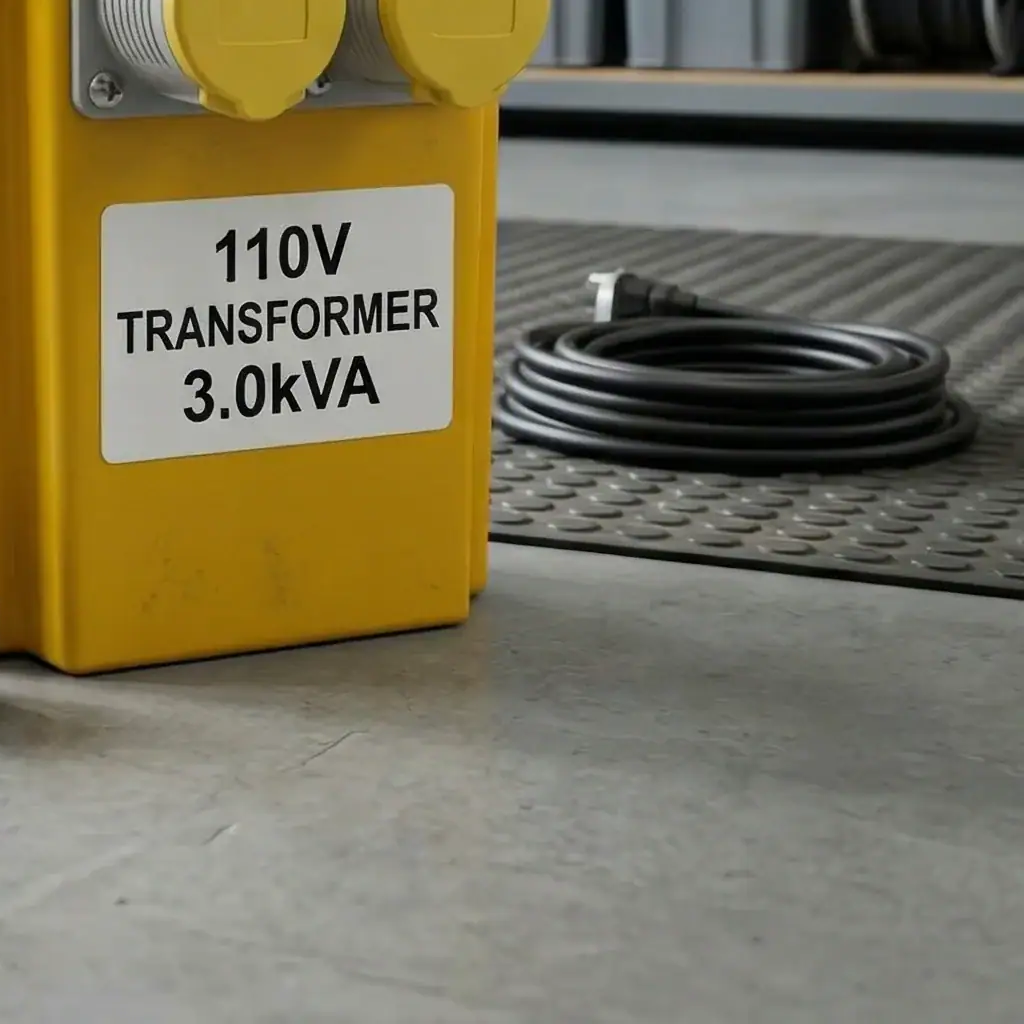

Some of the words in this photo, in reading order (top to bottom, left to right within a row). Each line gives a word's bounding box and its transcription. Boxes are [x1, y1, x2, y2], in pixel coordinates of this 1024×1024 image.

[215, 221, 352, 283] 110V
[116, 288, 440, 354] TRANSFORMER
[183, 355, 381, 423] 3.0kVA
